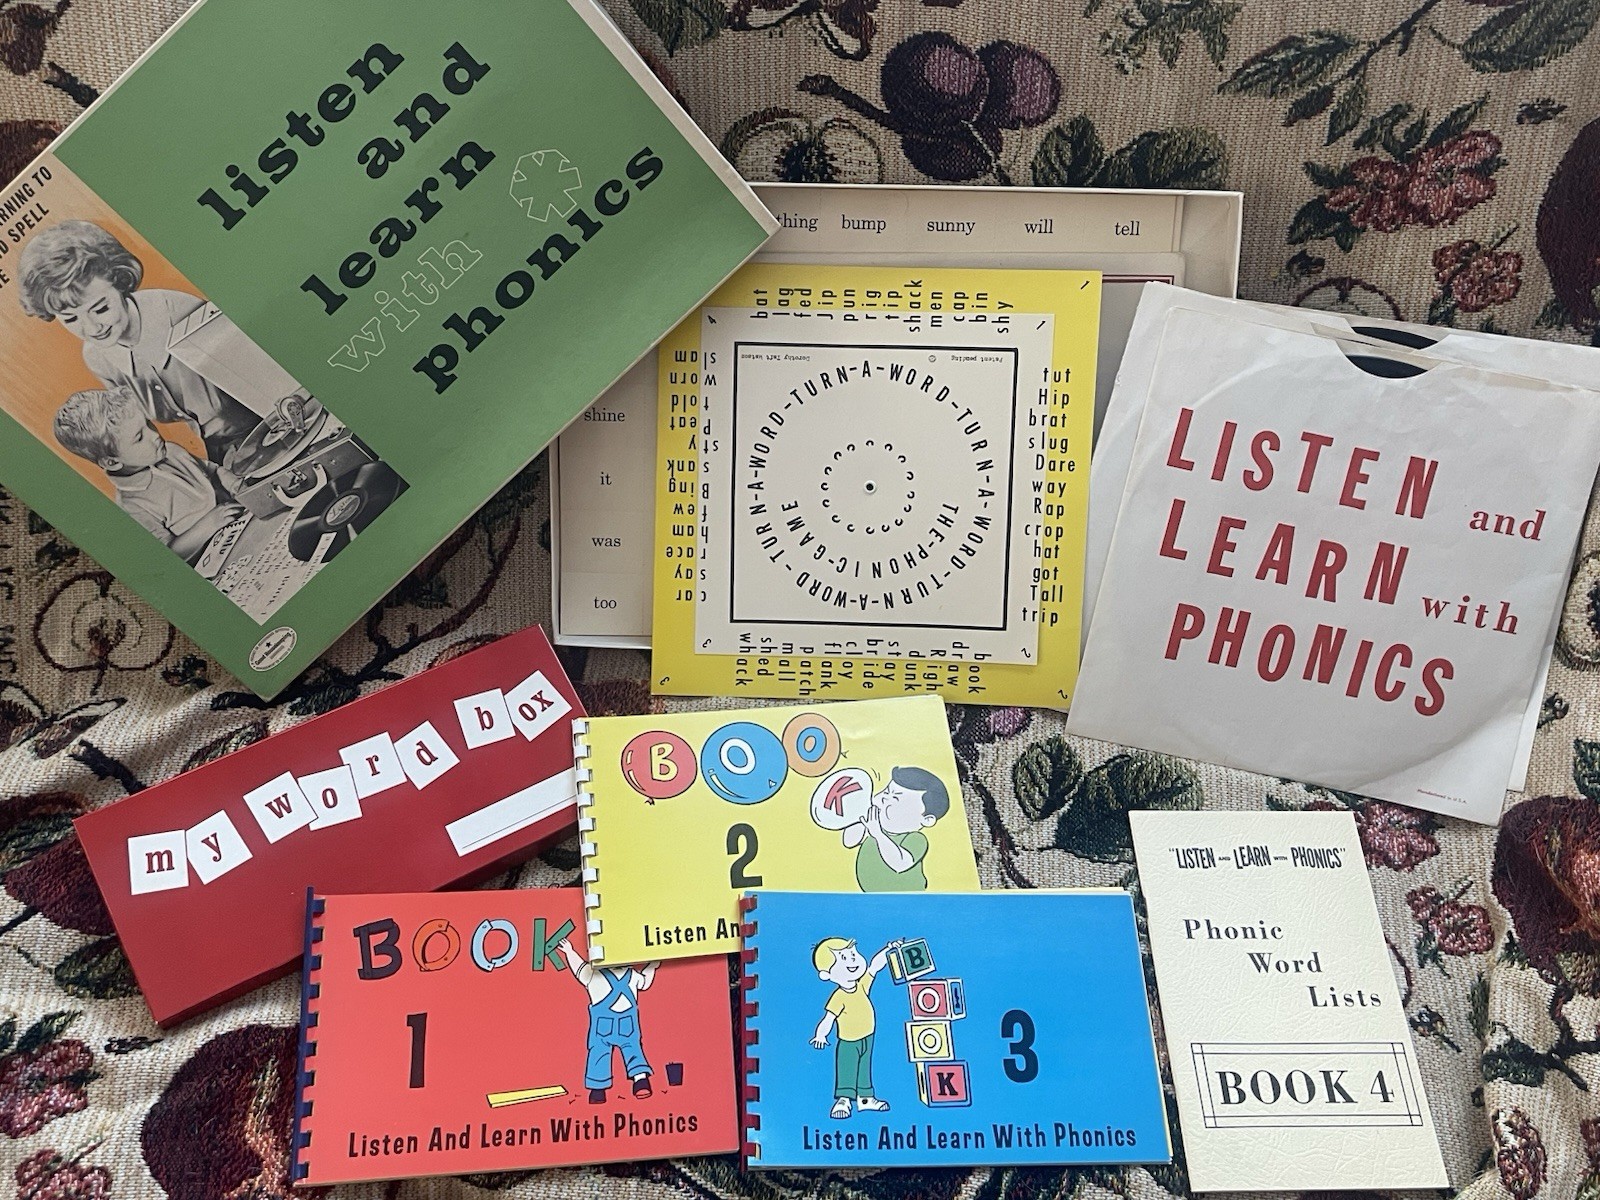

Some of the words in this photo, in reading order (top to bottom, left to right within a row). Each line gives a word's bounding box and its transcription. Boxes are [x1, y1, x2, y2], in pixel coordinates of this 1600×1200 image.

[356, 41, 491, 180] and
[197, 39, 405, 231] listen
[0, 183, 35, 226] RNING
[32, 166, 52, 187] TO
[8, 203, 49, 242] SPELL
[300, 138, 496, 316] learn
[842, 215, 886, 233] bump
[928, 222, 975, 235] sunny
[1025, 219, 1052, 233] will
[1116, 221, 1139, 235] tell
[412, 145, 665, 394] phonics
[327, 239, 483, 373] with
[750, 289, 767, 318] bat
[772, 288, 793, 315] lag
[794, 289, 811, 317] fed
[844, 290, 858, 321] pun
[862, 291, 881, 319] rig
[883, 291, 902, 319] tip
[904, 280, 922, 332] shack
[931, 292, 942, 327] men
[954, 292, 969, 321] cap
[969, 293, 987, 322] bin
[992, 302, 1013, 333] shy
[675, 351, 715, 370] slam
[670, 373, 716, 385] worn
[1044, 368, 1070, 382] tut
[672, 395, 708, 412] told
[1039, 389, 1069, 408] Hip
[585, 407, 624, 421] shine
[670, 417, 710, 434] peat
[1029, 408, 1066, 427] brat
[689, 435, 718, 453] sty
[1029, 432, 1068, 453] slug
[668, 460, 709, 480] sank
[1036, 454, 1075, 471] Dare
[1167, 407, 1439, 519] LISTEN
[1468, 509, 1547, 541] and
[601, 475, 611, 485] it
[669, 476, 708, 499] Bing
[1033, 481, 1066, 497] way
[674, 504, 707, 522] few
[1035, 498, 1064, 519] Rap
[592, 538, 620, 546] was
[673, 525, 708, 543] ham
[1025, 525, 1063, 541] crop
[667, 547, 705, 559] race
[1034, 540, 1059, 558] hat
[675, 564, 705, 580] say
[1033, 567, 1058, 582] got
[1159, 498, 1409, 605] LEARN
[1421, 596, 1520, 635] with
[595, 599, 616, 608] too
[677, 590, 706, 601] car
[1031, 585, 1062, 602] Tall
[1023, 608, 1057, 626] trip
[736, 633, 756, 685] whack
[758, 638, 777, 675] shed
[779, 643, 795, 681] mall
[821, 643, 841, 688] flank
[836, 642, 863, 678] cloy
[863, 639, 886, 688] bride
[878, 642, 901, 681] stay
[905, 651, 925, 690] dunk
[947, 642, 969, 685] draw
[1164, 603, 1455, 717] PHONICS
[799, 647, 816, 695] patch
[969, 654, 991, 693] book
[145, 831, 223, 874] my
[265, 741, 439, 819] word
[475, 689, 555, 732] box
[726, 823, 763, 889] 2
[1234, 846, 1271, 869] LEARN
[645, 925, 706, 946] Listen
[1185, 920, 1281, 939] Phonic
[353, 918, 577, 981] BOOK
[1247, 952, 1322, 973] Word
[1308, 986, 1380, 1006] Lists
[406, 1012, 428, 1088] 1
[1000, 1009, 1039, 1083] 3
[1216, 1070, 1357, 1104] BOOK
[1371, 1071, 1394, 1102] 4
[349, 1133, 417, 1157] Listen
[429, 1125, 470, 1151] And
[481, 1124, 540, 1148] Learn
[551, 1116, 604, 1142] With
[615, 1113, 697, 1137] Phonics
[804, 1126, 867, 1150] Listen
[878, 1125, 916, 1149] And
[927, 1126, 984, 1149] Learn
[993, 1124, 1046, 1148] With
[1054, 1123, 1136, 1146] Phonics
